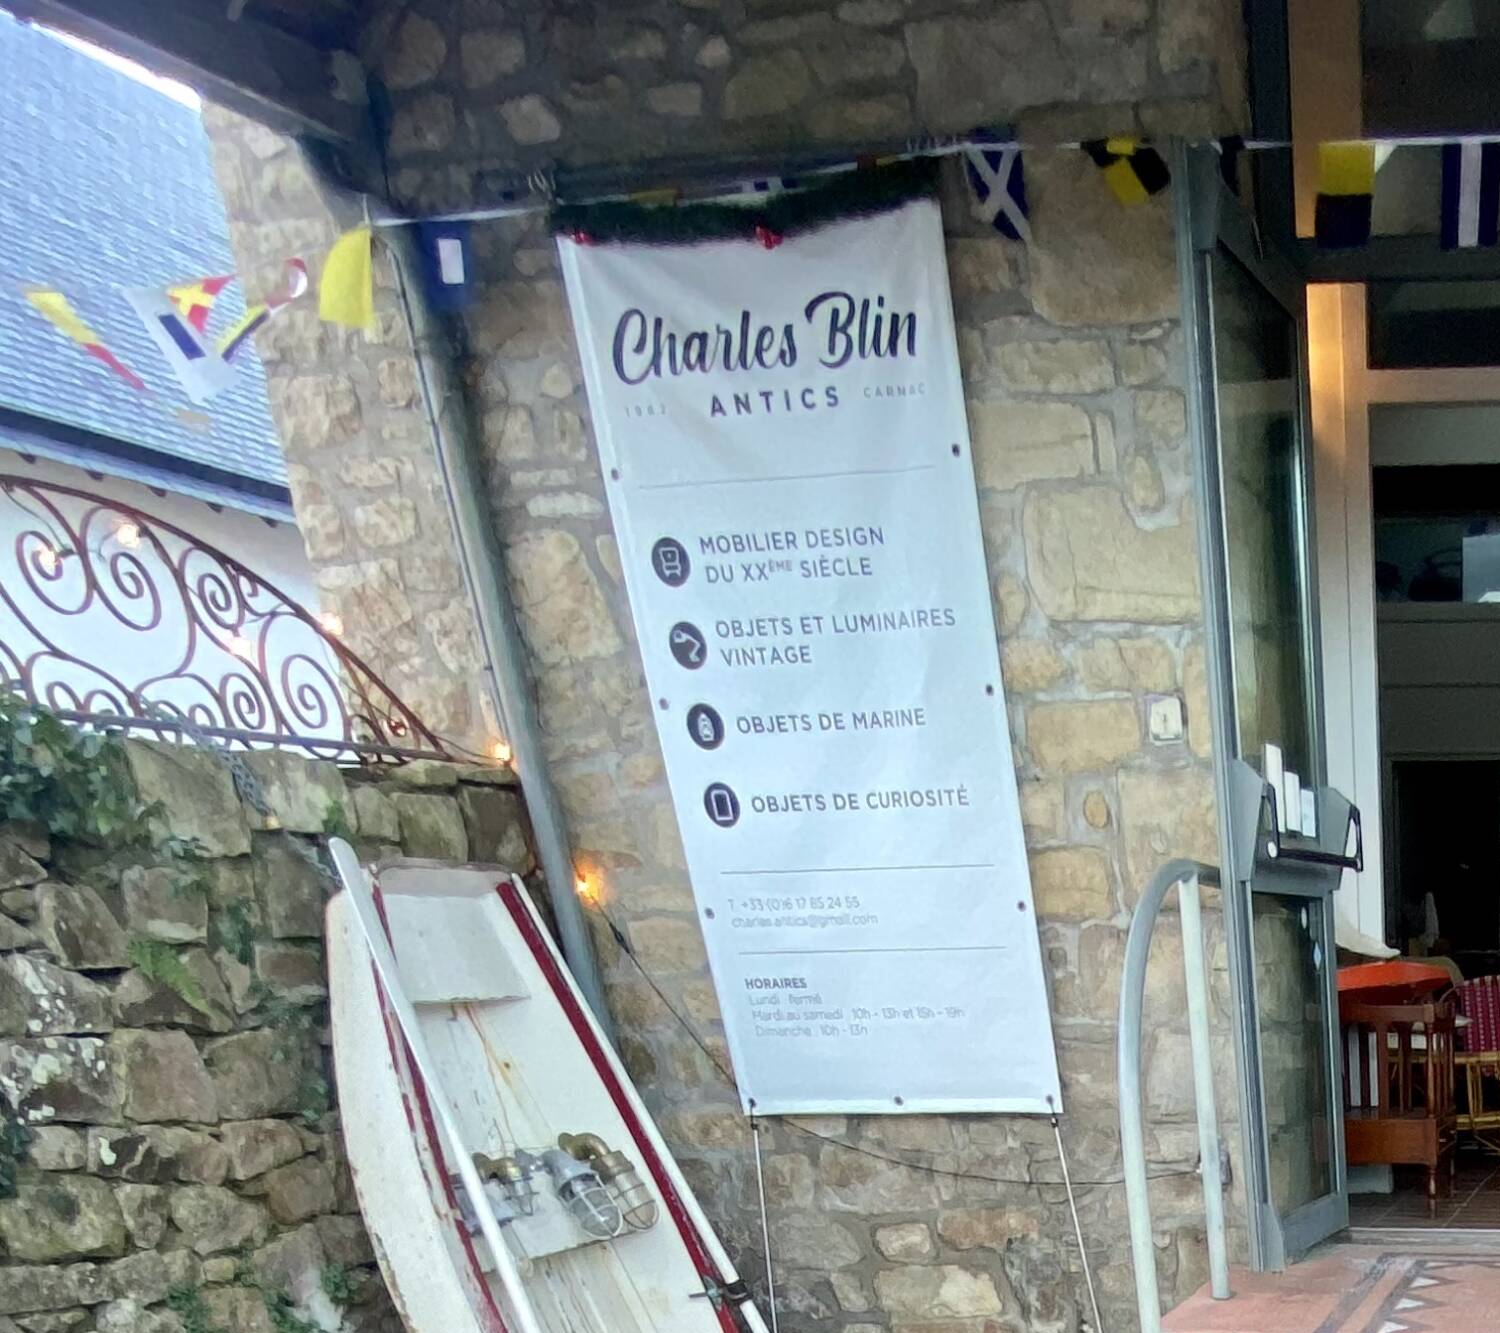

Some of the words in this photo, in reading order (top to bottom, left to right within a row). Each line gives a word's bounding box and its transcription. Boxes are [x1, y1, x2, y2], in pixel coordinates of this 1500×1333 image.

[613, 308, 798, 385] Charles
[805, 291, 917, 369] Blin
[710, 385, 840, 418] ANTICS
[863, 382, 926, 399] CARNAC
[699, 530, 798, 555] MOBILIER
[805, 526, 885, 549] DESIGN
[706, 564, 734, 584] DU
[800, 554, 873, 579] SIÈCLE
[715, 616, 793, 638] OBJETS
[801, 615, 824, 635] ET
[832, 608, 956, 634] LUMINAIRES
[720, 645, 813, 667] VINTAGE
[736, 714, 812, 734] OBJETS
[818, 713, 846, 731] DE
[852, 708, 926, 730] MARINE
[751, 794, 827, 813] OBJETS
[832, 793, 860, 811] DE
[866, 784, 970, 810] CURIOSITÉ
[744, 978, 808, 990] HORAIRES
